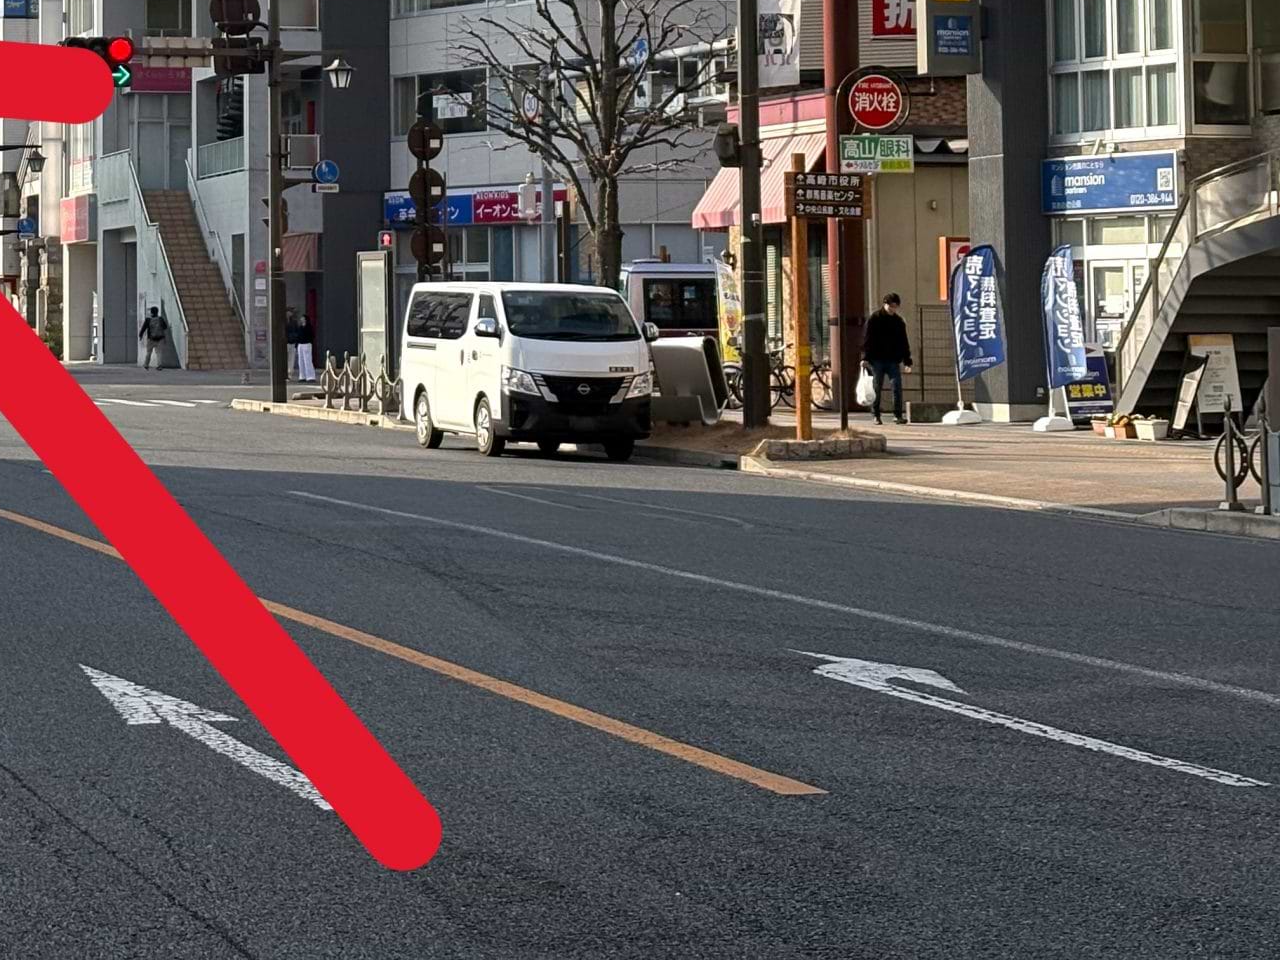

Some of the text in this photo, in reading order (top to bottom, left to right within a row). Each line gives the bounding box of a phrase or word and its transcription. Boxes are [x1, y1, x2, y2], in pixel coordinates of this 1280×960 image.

[854, 91, 898, 113] 消火栓
[843, 139, 910, 158] 高山眼科
[1064, 172, 1105, 187] mansion
